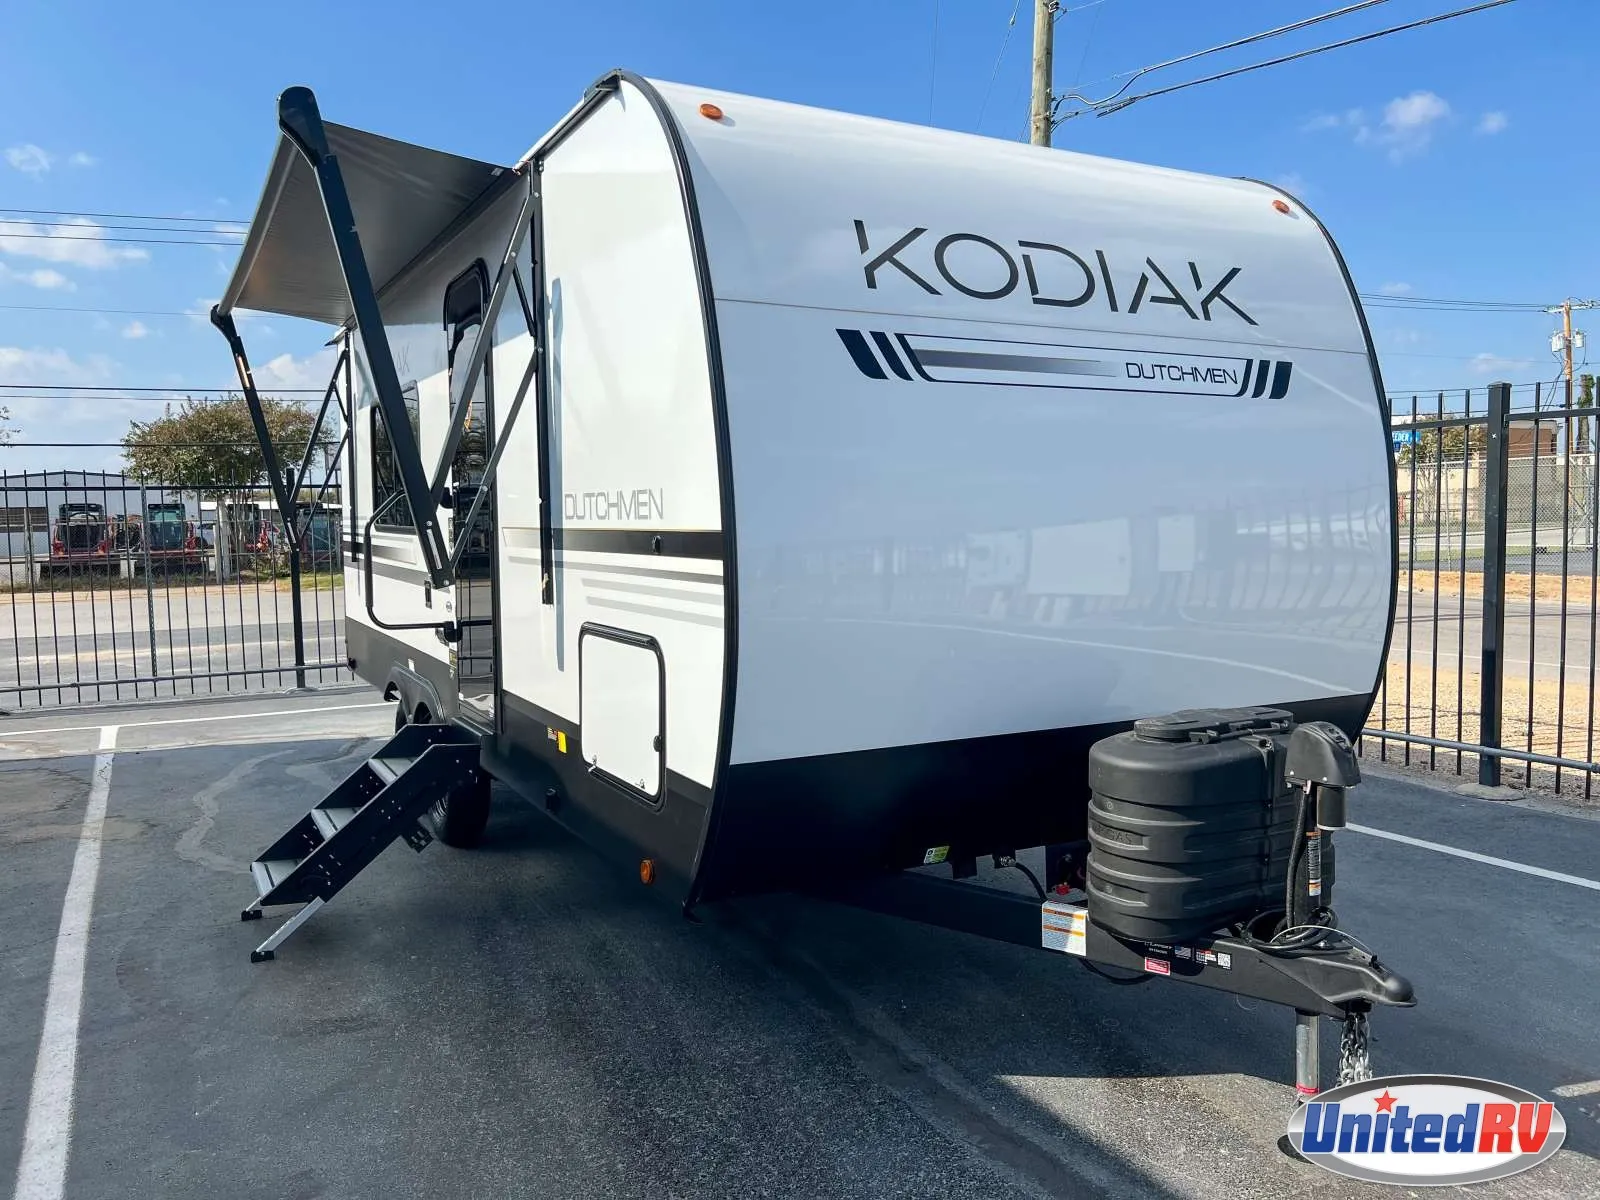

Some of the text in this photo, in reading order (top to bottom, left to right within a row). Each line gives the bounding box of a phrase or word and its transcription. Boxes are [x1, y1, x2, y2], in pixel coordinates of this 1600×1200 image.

[853, 219, 1259, 326] KODIAK
[1125, 362, 1238, 385] DUTCHMEN
[564, 488, 664, 521] DUTCHMEN
